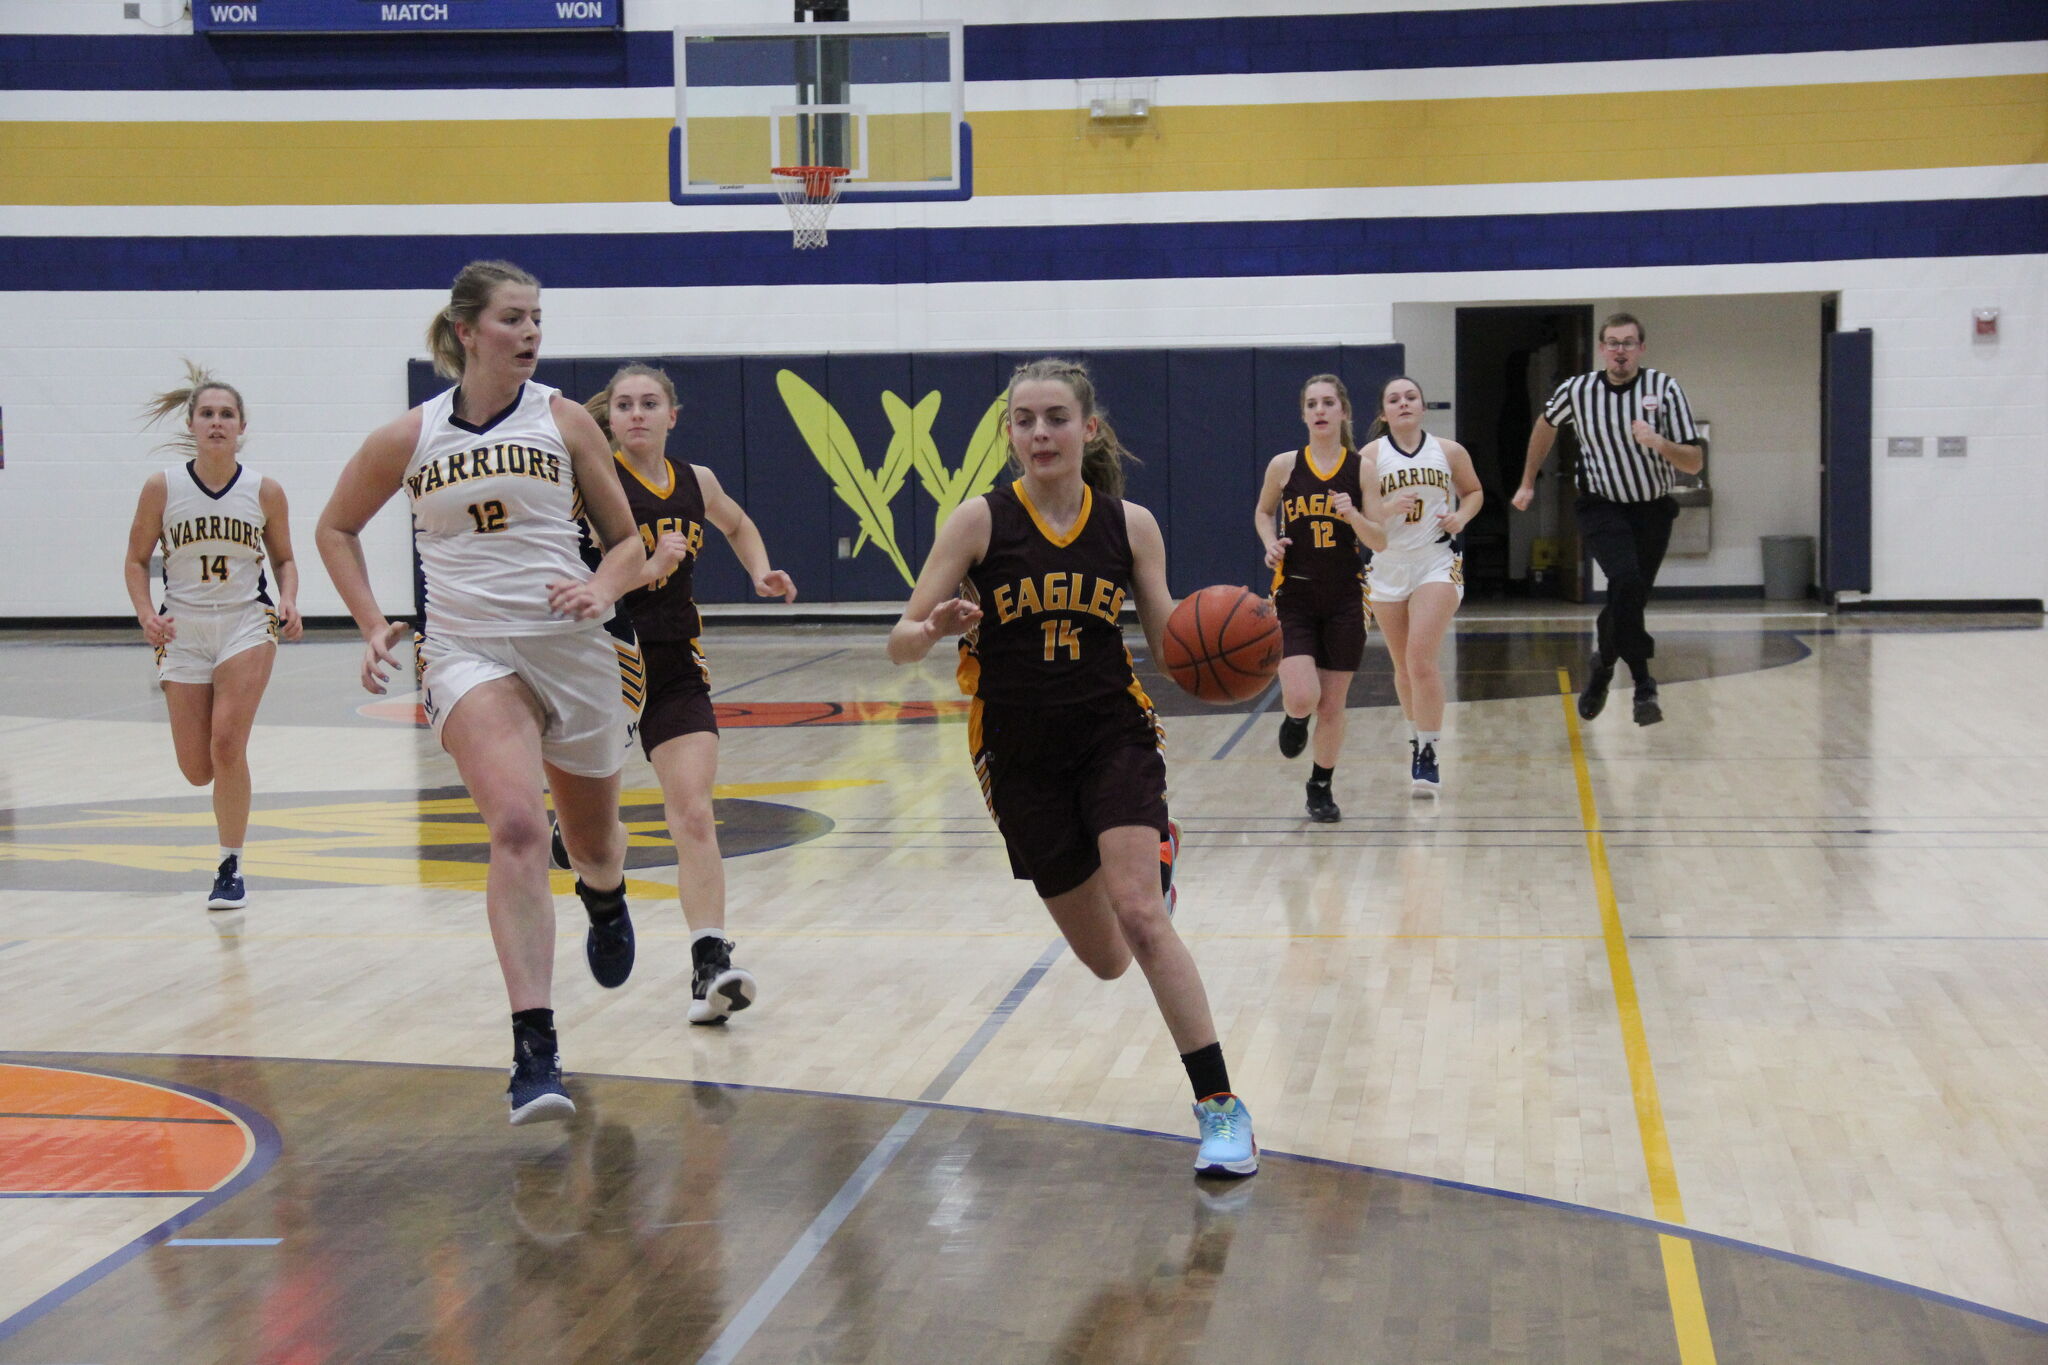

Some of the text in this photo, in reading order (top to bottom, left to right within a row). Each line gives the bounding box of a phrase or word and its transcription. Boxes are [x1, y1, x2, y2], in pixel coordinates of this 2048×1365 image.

[211, 5, 257, 22] WON
[381, 4, 448, 21] MATCH
[556, 2, 602, 19] WON
[407, 444, 561, 501] WARRIORS
[170, 515, 261, 549] WARRIORS
[468, 500, 509, 534] 12
[1310, 521, 1337, 548] 12
[200, 555, 229, 583] 14
[993, 571, 1127, 626] EAGLES
[1040, 619, 1083, 662] 14
